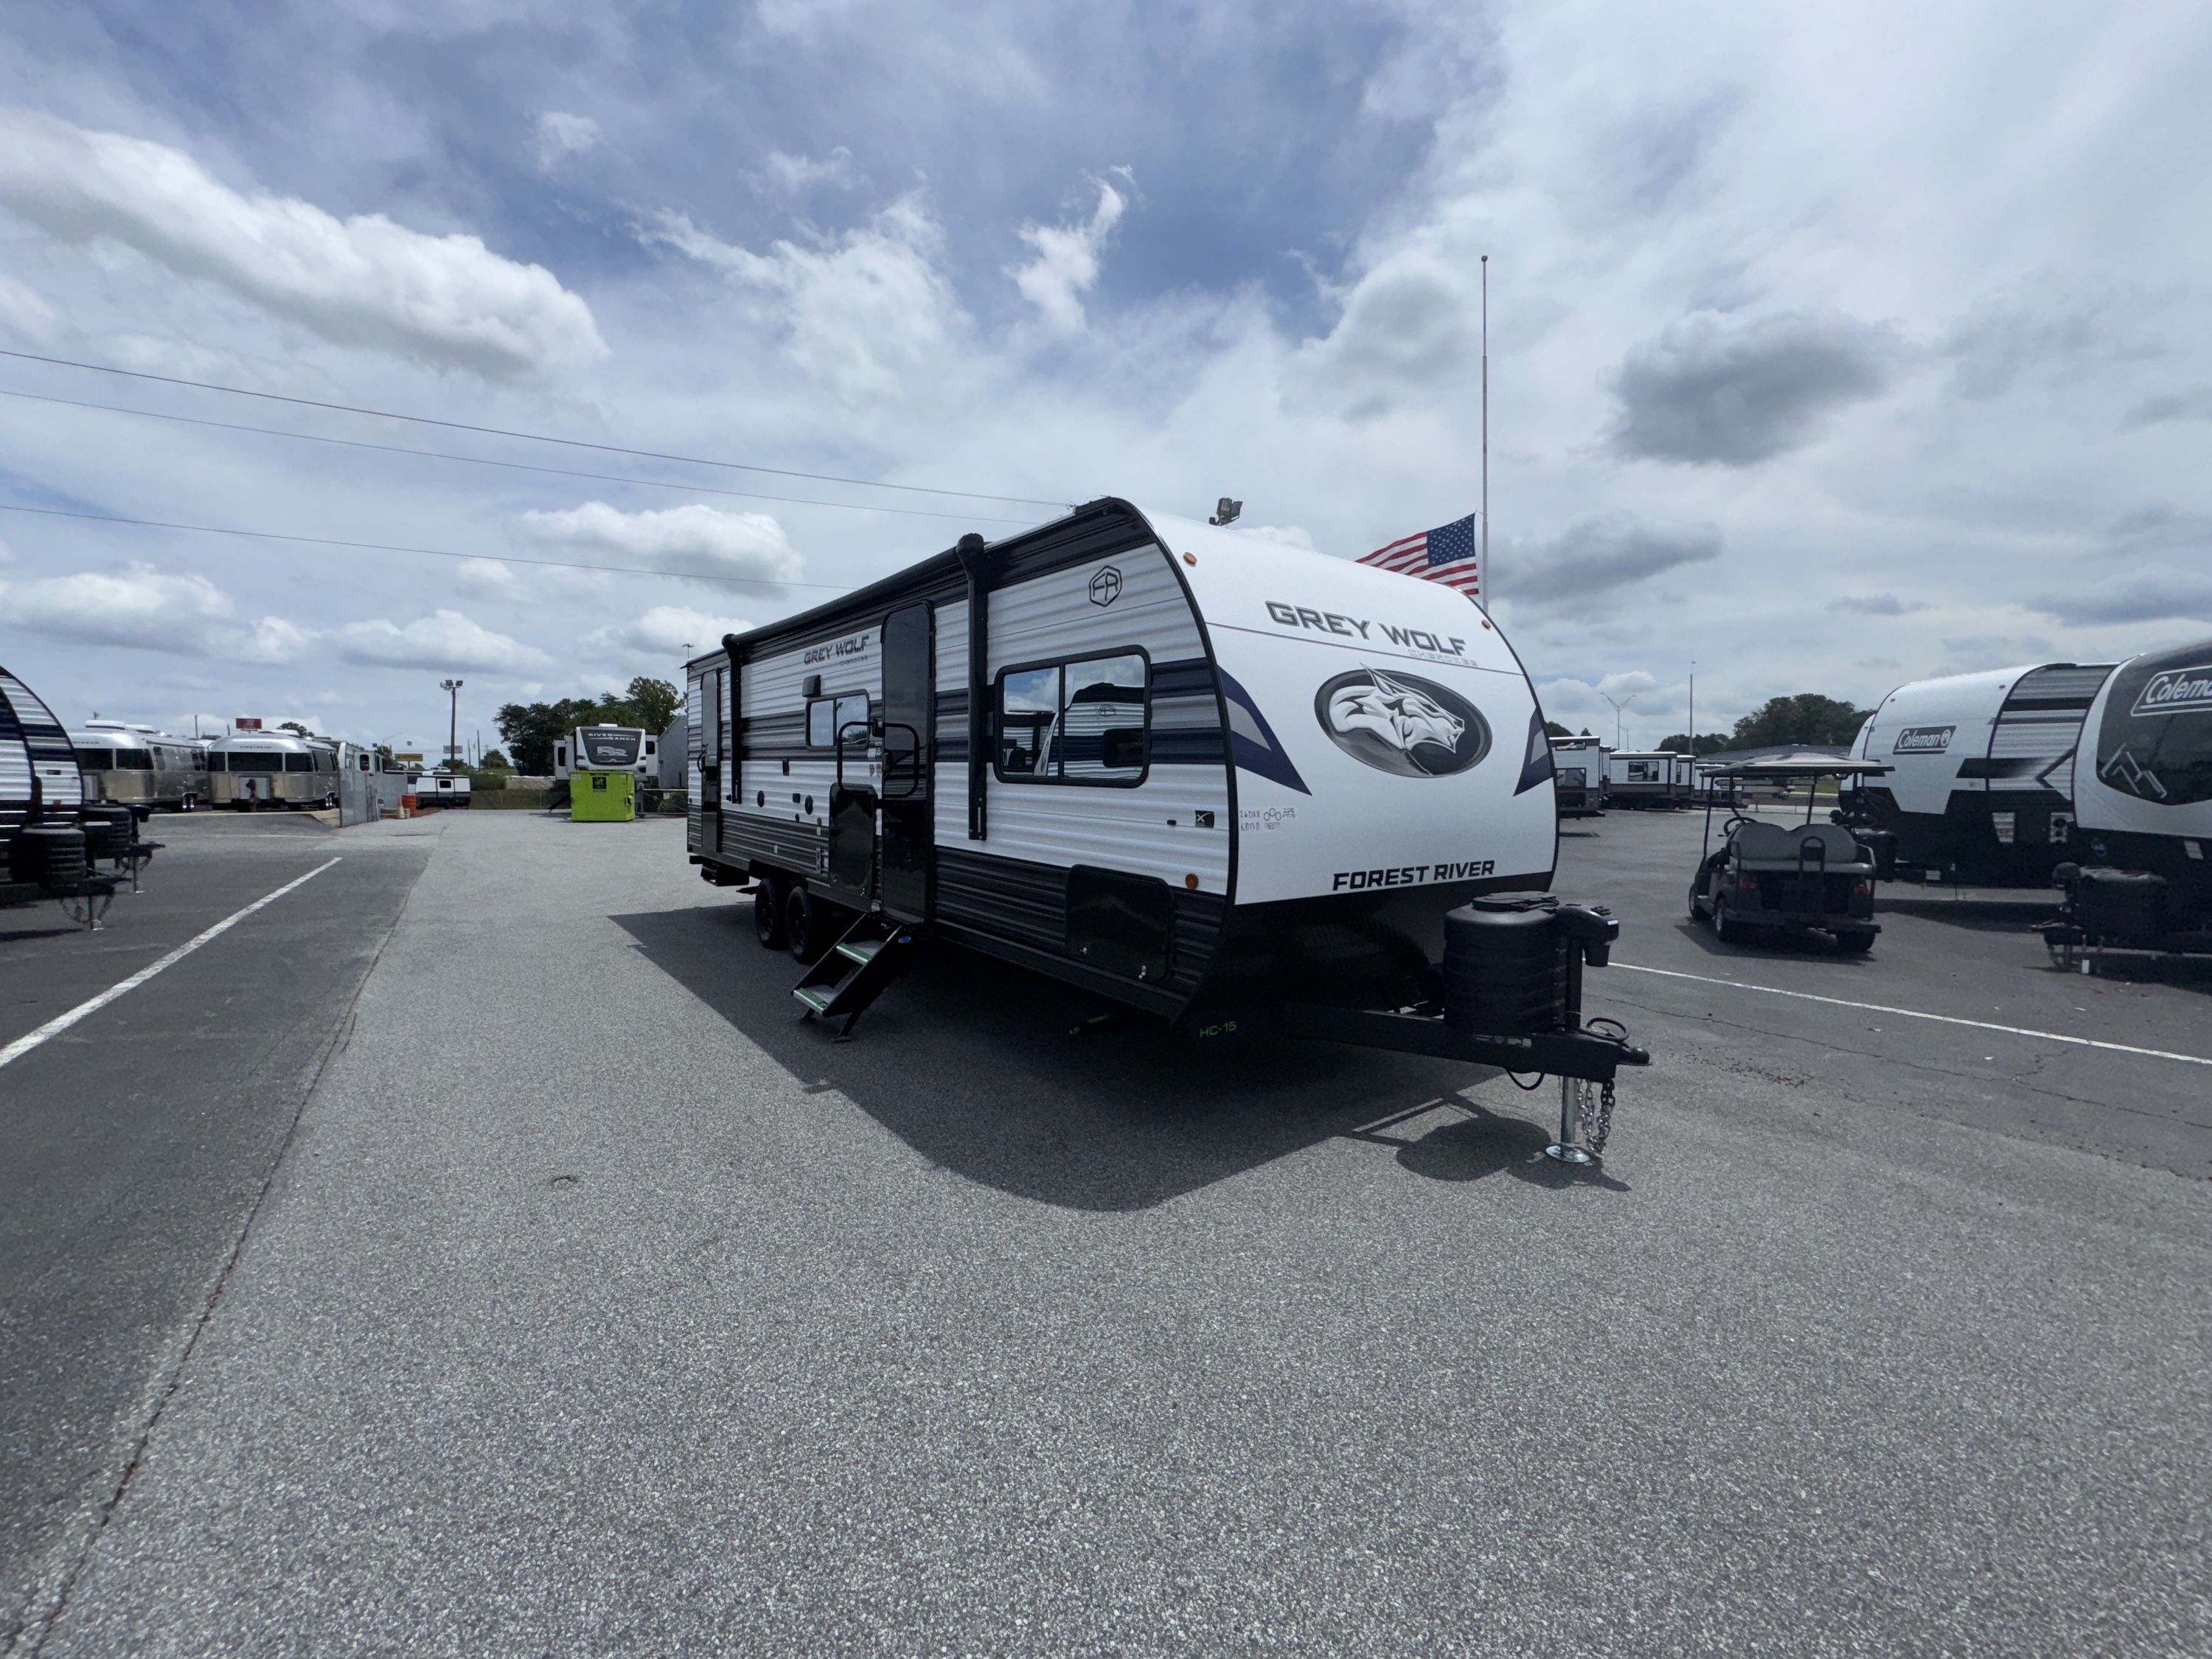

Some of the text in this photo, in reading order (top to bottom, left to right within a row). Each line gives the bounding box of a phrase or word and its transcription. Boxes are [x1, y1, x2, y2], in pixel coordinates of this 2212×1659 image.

[1265, 600, 1466, 656] GREY WOLF
[804, 645, 832, 665] GREY
[836, 635, 869, 657] WOLF
[1408, 649, 1478, 667] CHEROKEE
[1899, 730, 1941, 748] Coleman
[1332, 860, 1495, 891] FOREST RIVER
